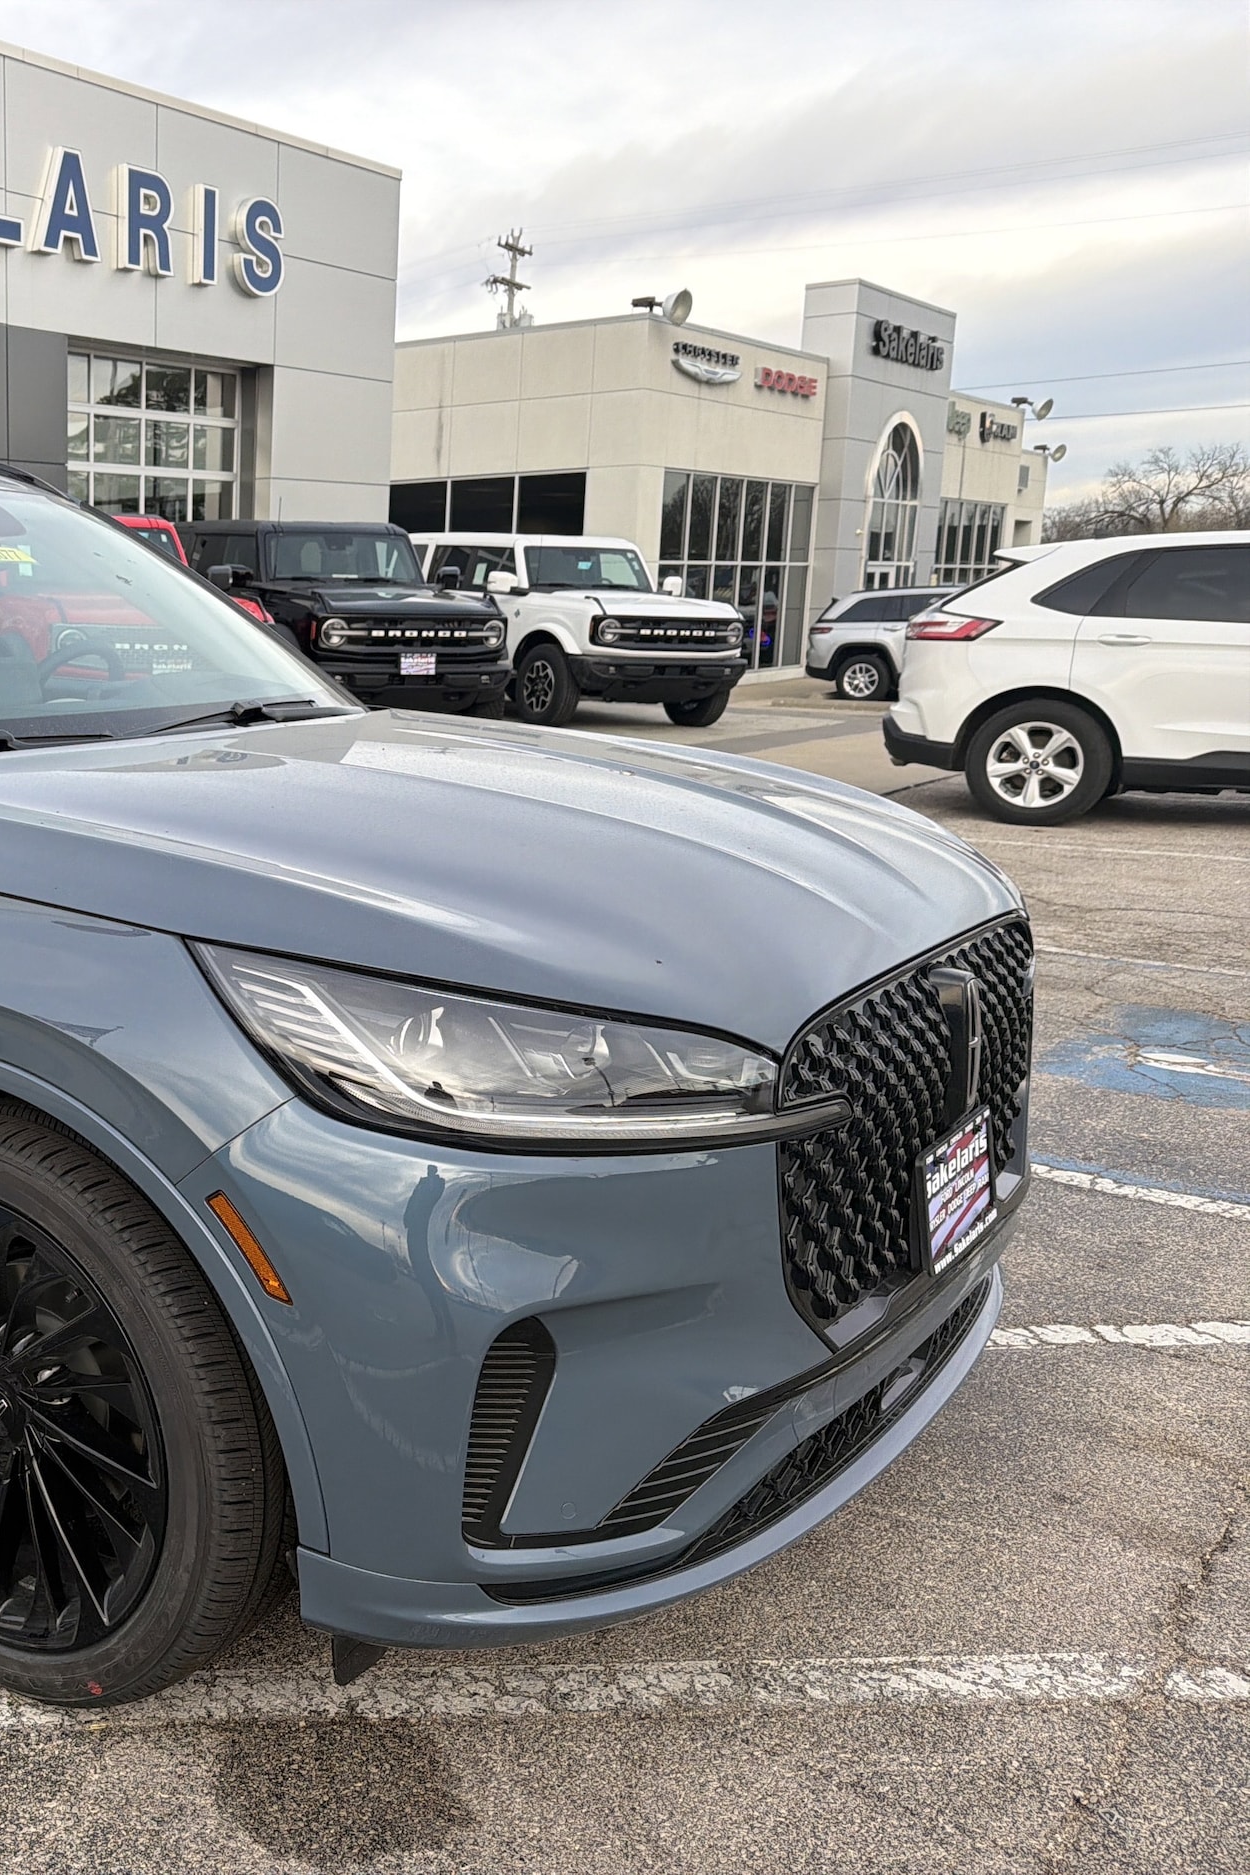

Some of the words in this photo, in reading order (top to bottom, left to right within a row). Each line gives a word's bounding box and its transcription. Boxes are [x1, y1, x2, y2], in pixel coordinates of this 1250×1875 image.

[874, 319, 945, 371] Sakelaris
[759, 366, 818, 397] DODGE
[371, 630, 467, 638] BRONCO
[639, 628, 716, 637] BRONCO
[954, 1168, 975, 1193] LINCOLN
[947, 1194, 964, 1215] DODGE
[934, 1208, 998, 1275] www.Sakelaris.com
